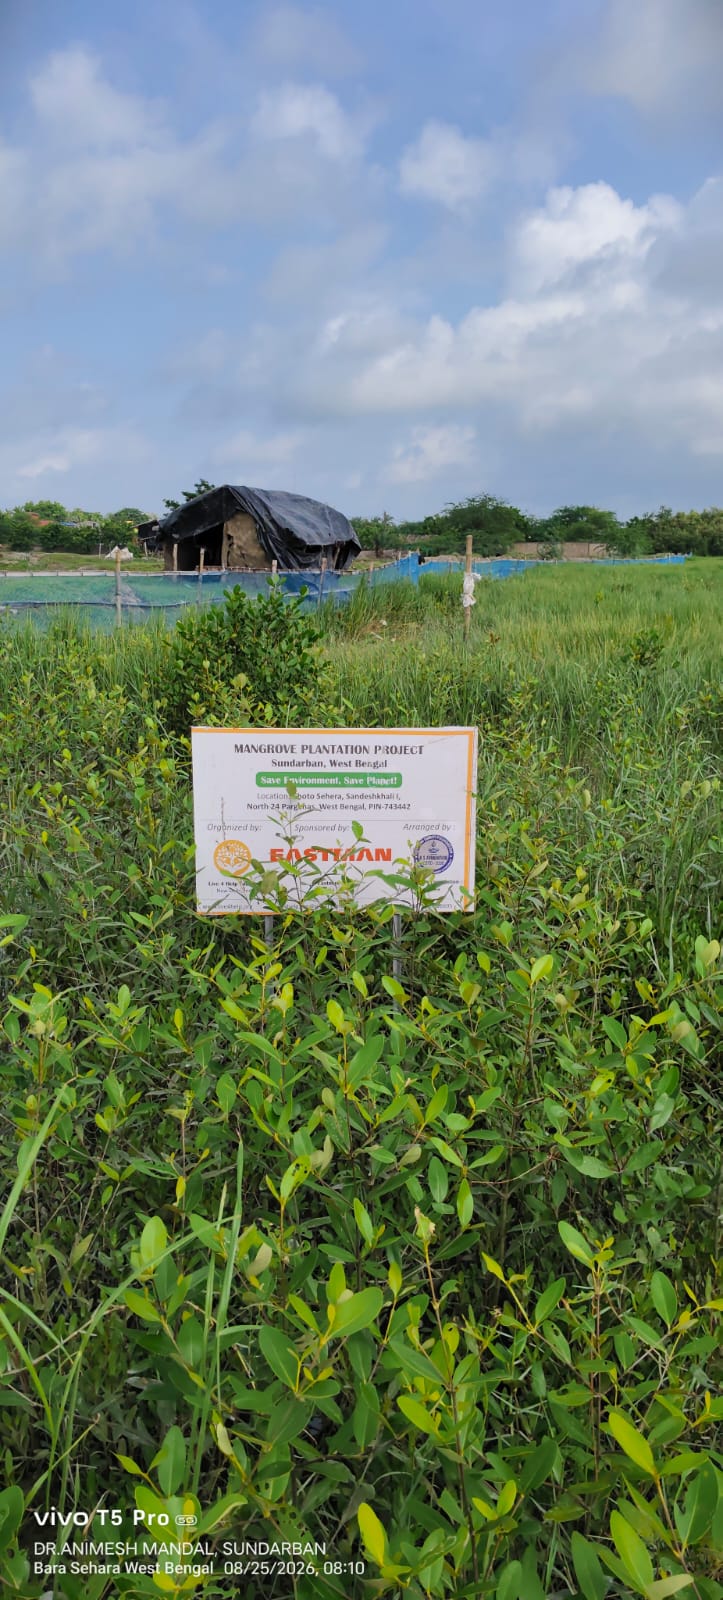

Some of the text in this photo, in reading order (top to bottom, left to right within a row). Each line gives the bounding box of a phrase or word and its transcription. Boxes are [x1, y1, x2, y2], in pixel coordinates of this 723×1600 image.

[234, 744, 424, 755] MANGROVE PLANTATION PROJECT
[271, 759, 387, 769] Sundarban, West Bengal
[260, 776, 281, 785] Save
[344, 776, 364, 785] Save
[367, 776, 397, 786] Planet!
[316, 793, 344, 801] Sehera,
[345, 792, 394, 800] Sandeshkhali
[247, 802, 269, 810] North
[281, 803, 316, 811] Pargnas,
[340, 803, 366, 811] Bengal,
[207, 823, 248, 832] Organized
[294, 823, 350, 832] Sponsored by:
[403, 823, 440, 832] Arranged
[270, 848, 392, 862] EASTMAN
